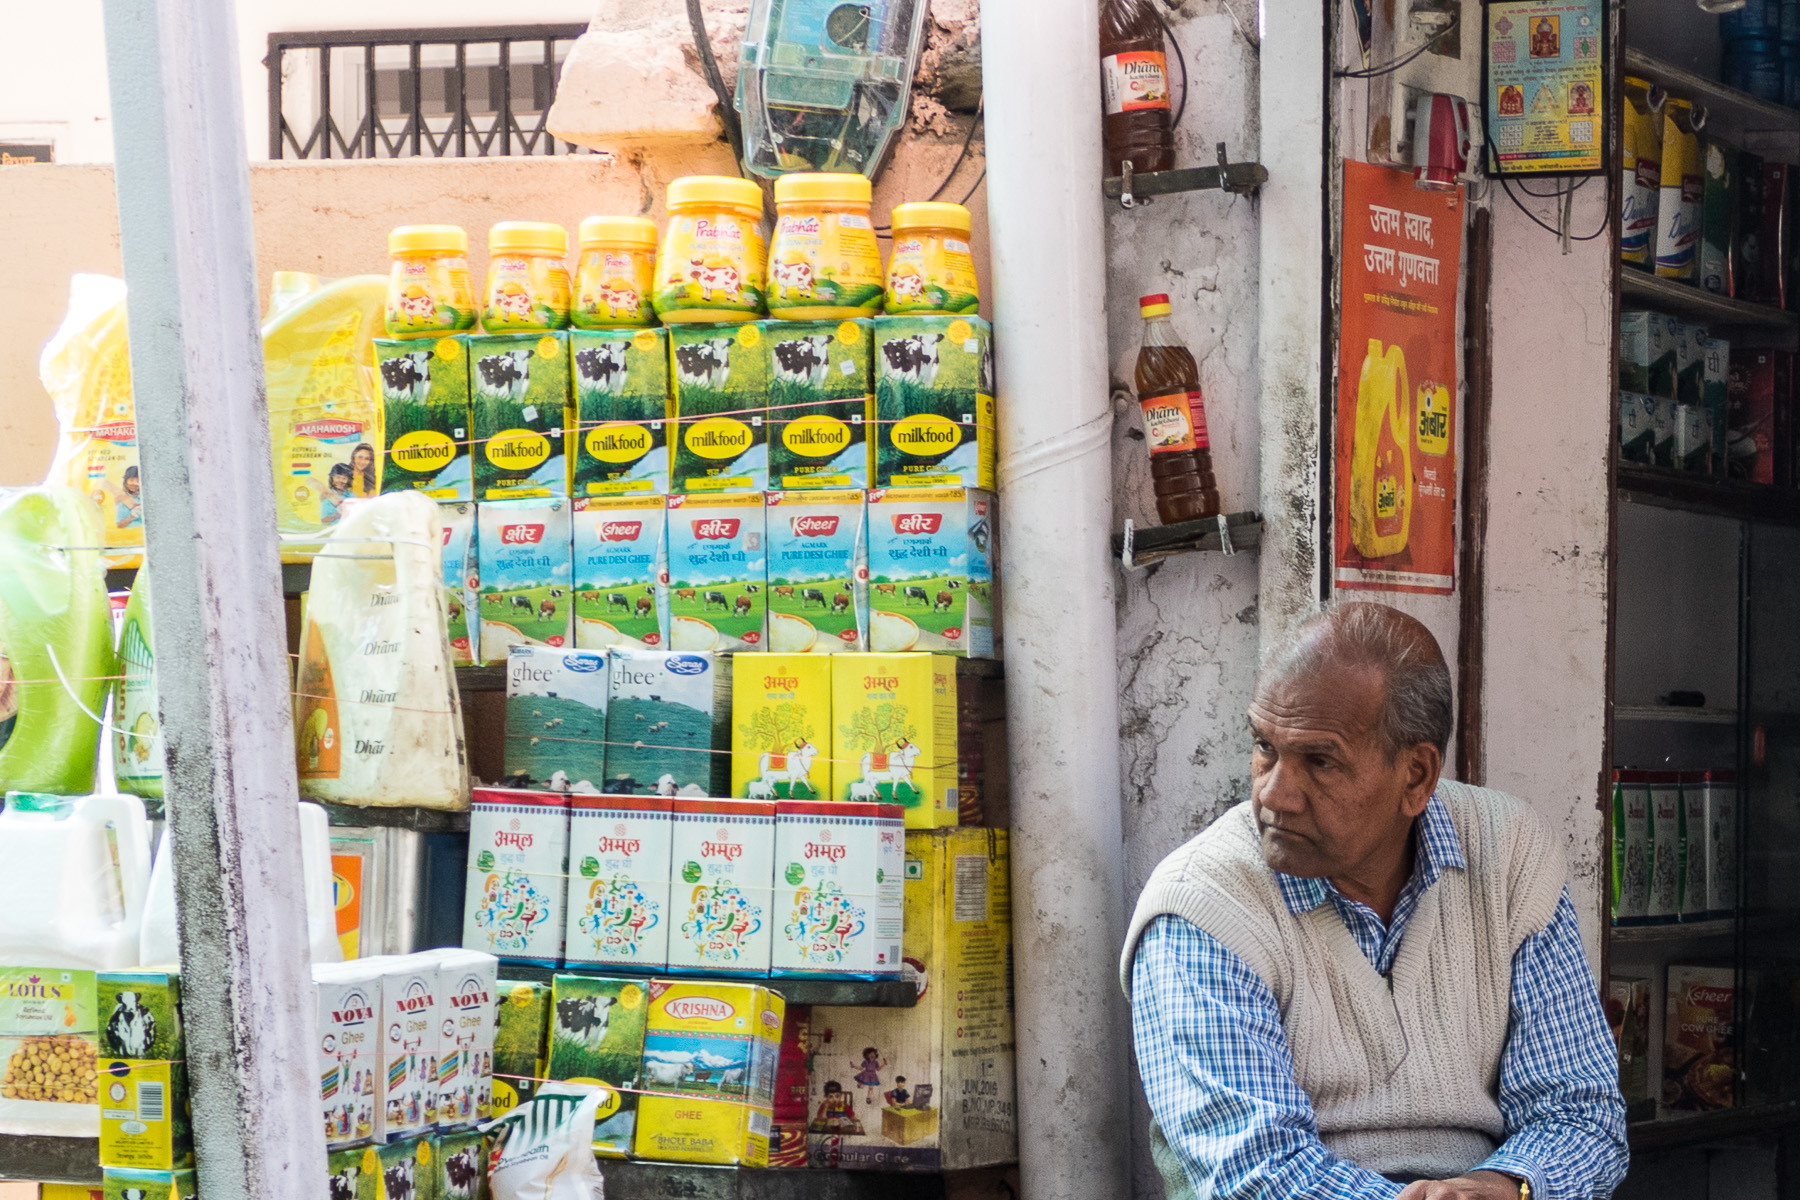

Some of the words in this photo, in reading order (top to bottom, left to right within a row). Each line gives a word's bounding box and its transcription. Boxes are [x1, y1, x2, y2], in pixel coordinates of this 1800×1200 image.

[1369, 203, 1400, 237] उत्तम
[1363, 242, 1395, 276] उत्तम
[1398, 249, 1439, 286] गुणवत्ता
[691, 428, 746, 447] milkfood
[789, 425, 843, 445] milkfood
[898, 424, 954, 444] milkfood
[492, 441, 543, 458] milkfood
[592, 435, 645, 452] milkfood
[699, 522, 731, 536] क्षीर
[791, 517, 836, 536] Ksheer
[899, 516, 933, 531] क्षीर
[512, 662, 553, 687] ghee
[613, 665, 655, 690] ghee
[396, 995, 434, 1012] NOVA
[449, 991, 489, 1009] NOVA
[1686, 985, 1732, 1004] Ksheer
[331, 1007, 374, 1024] NOVA
[672, 1001, 729, 1018] KRISHNA
[1681, 1023, 1704, 1035] COW
[1706, 1024, 1734, 1035] GHEE
